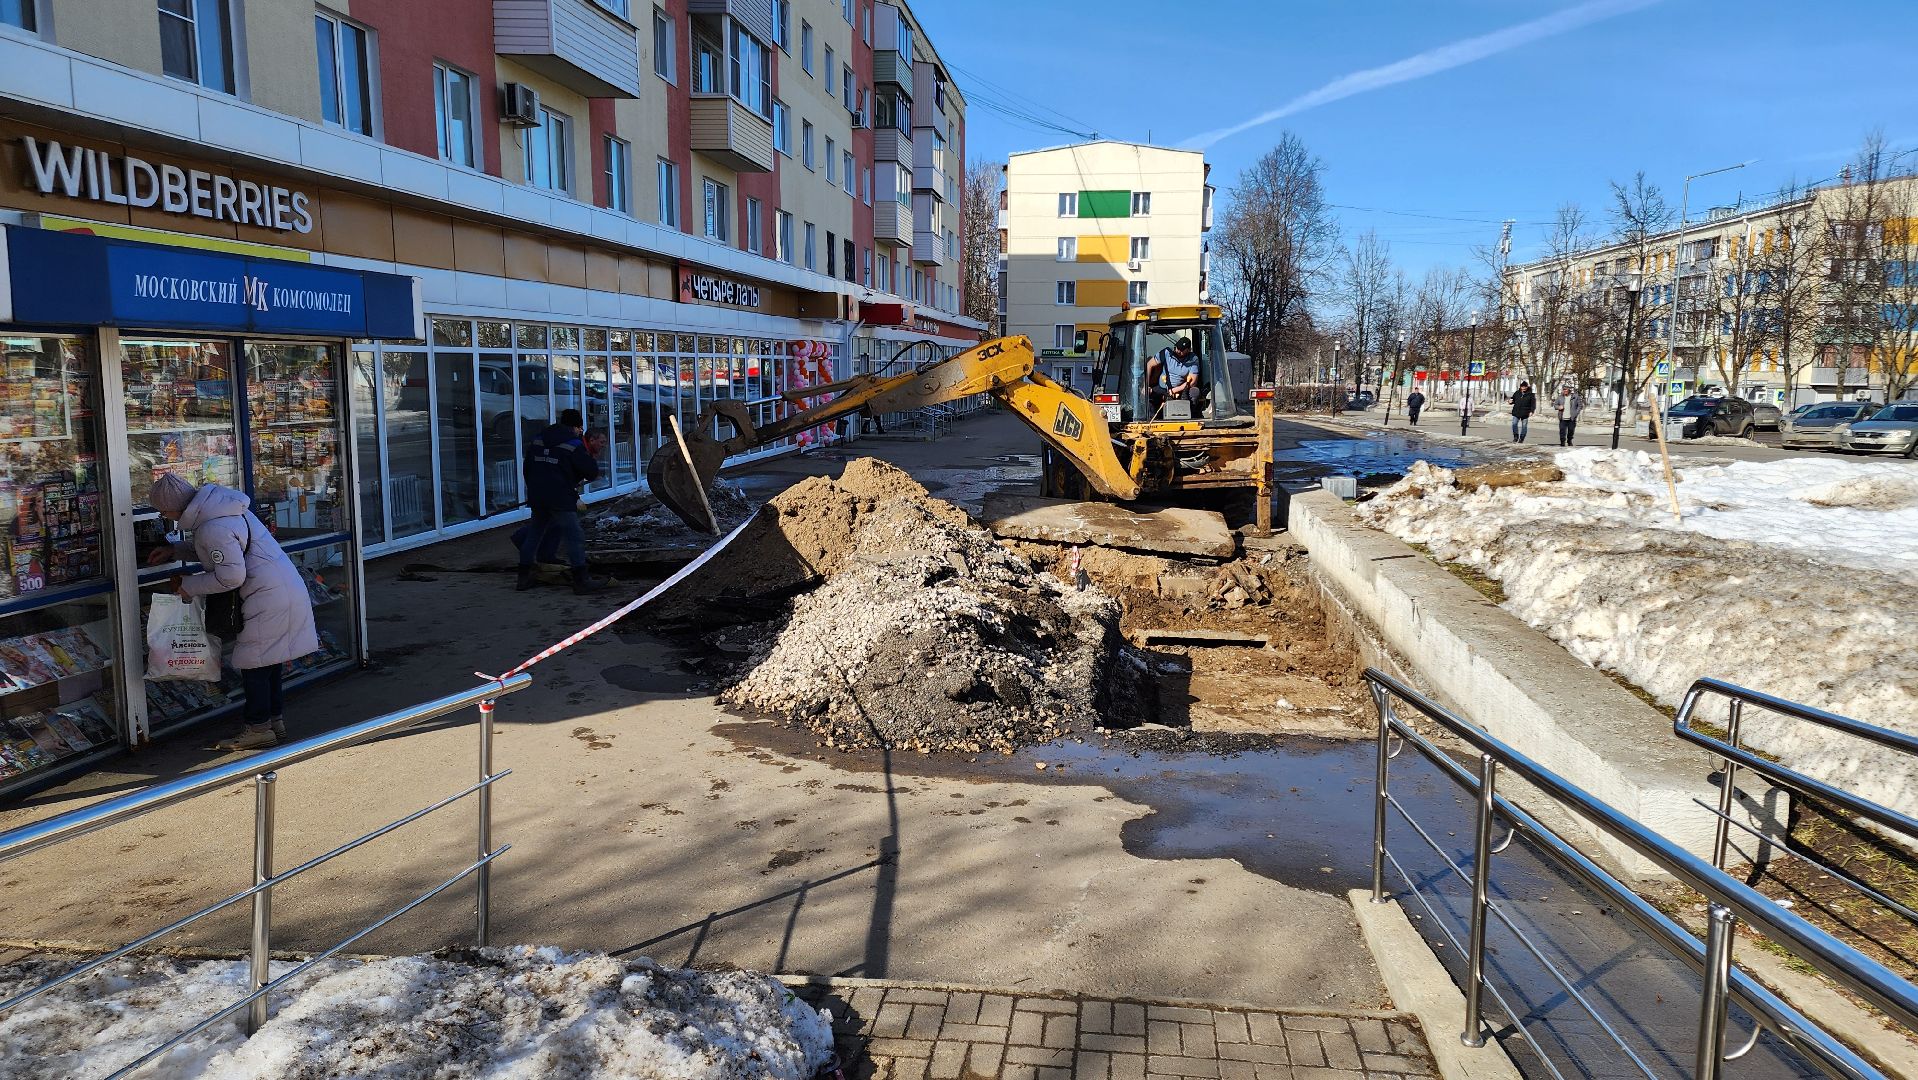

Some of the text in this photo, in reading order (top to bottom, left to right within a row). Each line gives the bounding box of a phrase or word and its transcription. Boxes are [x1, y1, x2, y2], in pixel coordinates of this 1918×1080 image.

[22, 136, 314, 234] WILDBERRIES
[134, 274, 351, 316] МОСКОВСКИЙ МК КОМСОМОЛЕЦ
[976, 342, 1005, 361] 3CX
[1054, 406, 1081, 439] JCB
[20, 577, 43, 590] 500
